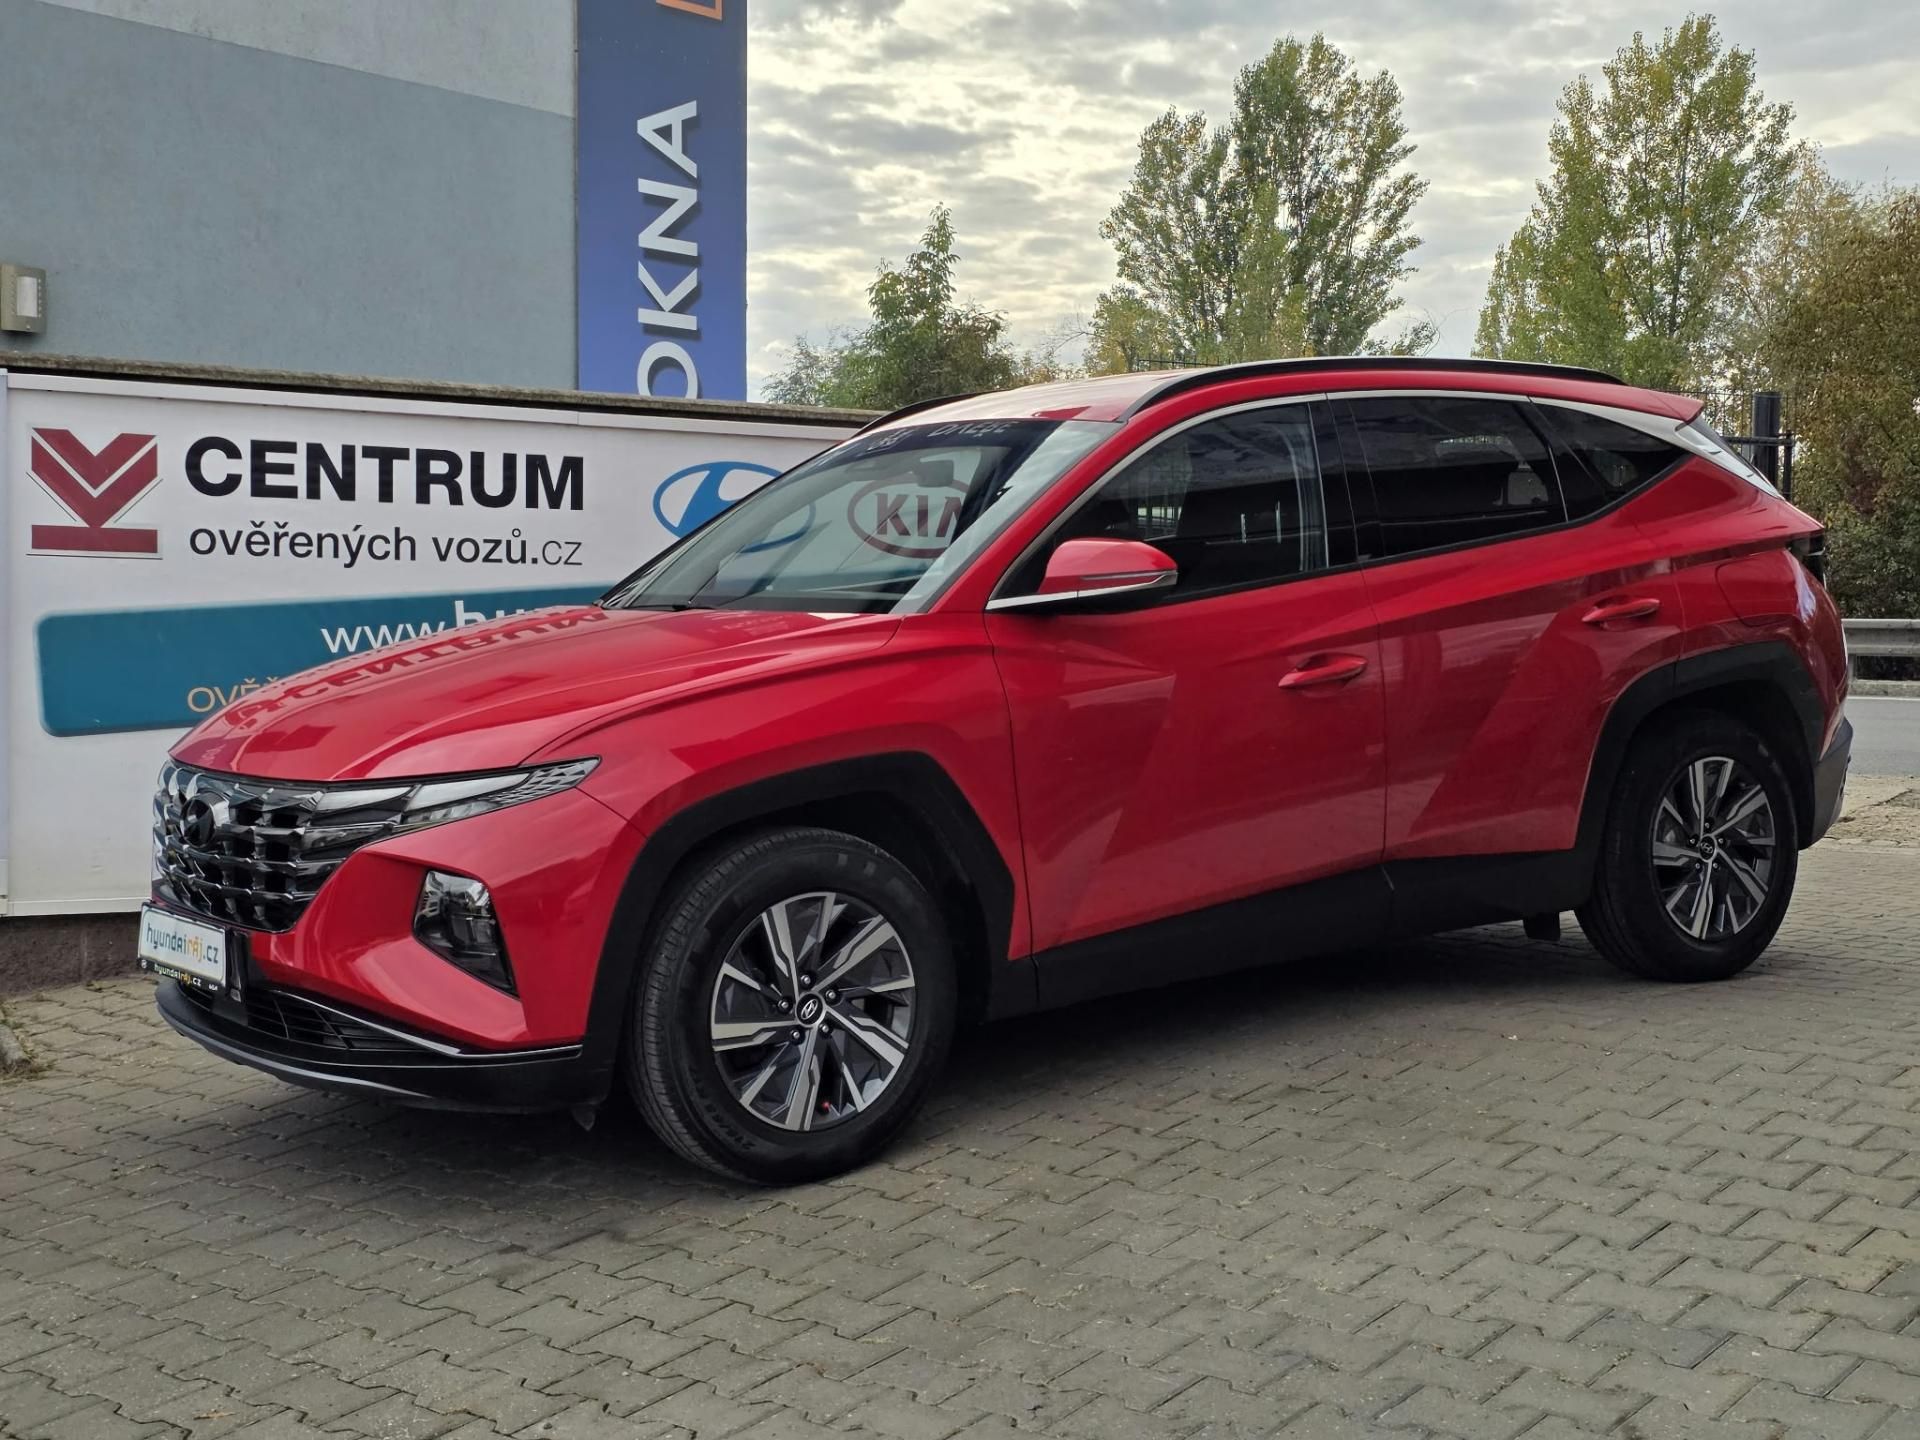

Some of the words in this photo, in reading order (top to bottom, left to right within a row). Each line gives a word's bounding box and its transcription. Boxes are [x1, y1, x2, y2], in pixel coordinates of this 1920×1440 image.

[637, 100, 699, 399] OKNA
[185, 436, 584, 511] CENTRUM
[190, 520, 416, 568] ověřených
[431, 528, 583, 566] vozů.cz
